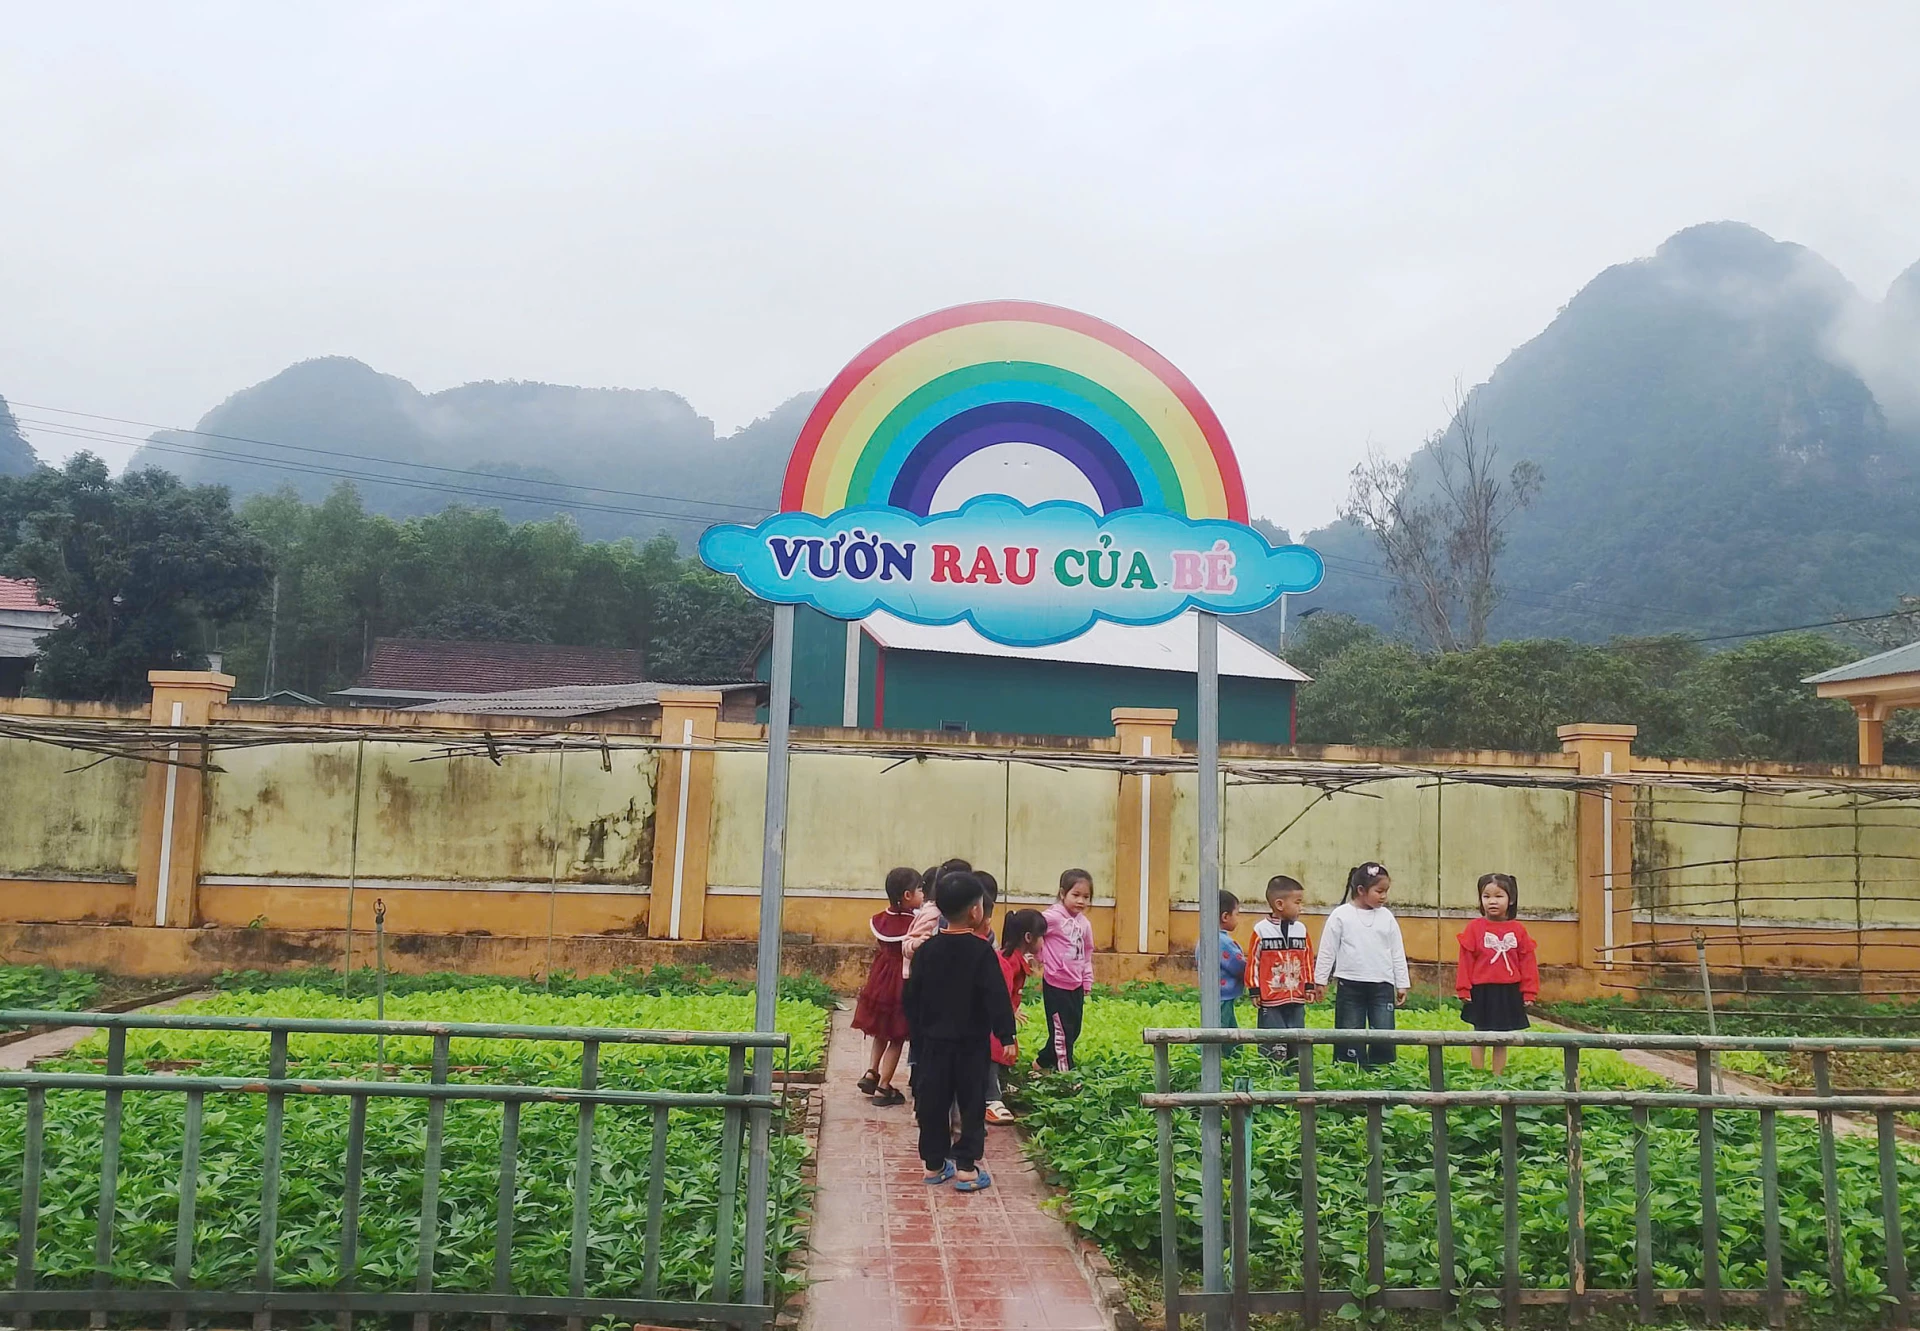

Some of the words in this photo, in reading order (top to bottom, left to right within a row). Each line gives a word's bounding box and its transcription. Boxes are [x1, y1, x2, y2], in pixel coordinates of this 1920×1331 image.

[768, 529, 918, 582] VƯỜN
[929, 543, 1040, 586] RAU
[1053, 534, 1159, 590] CỦA
[1171, 541, 1236, 593] BÉ
